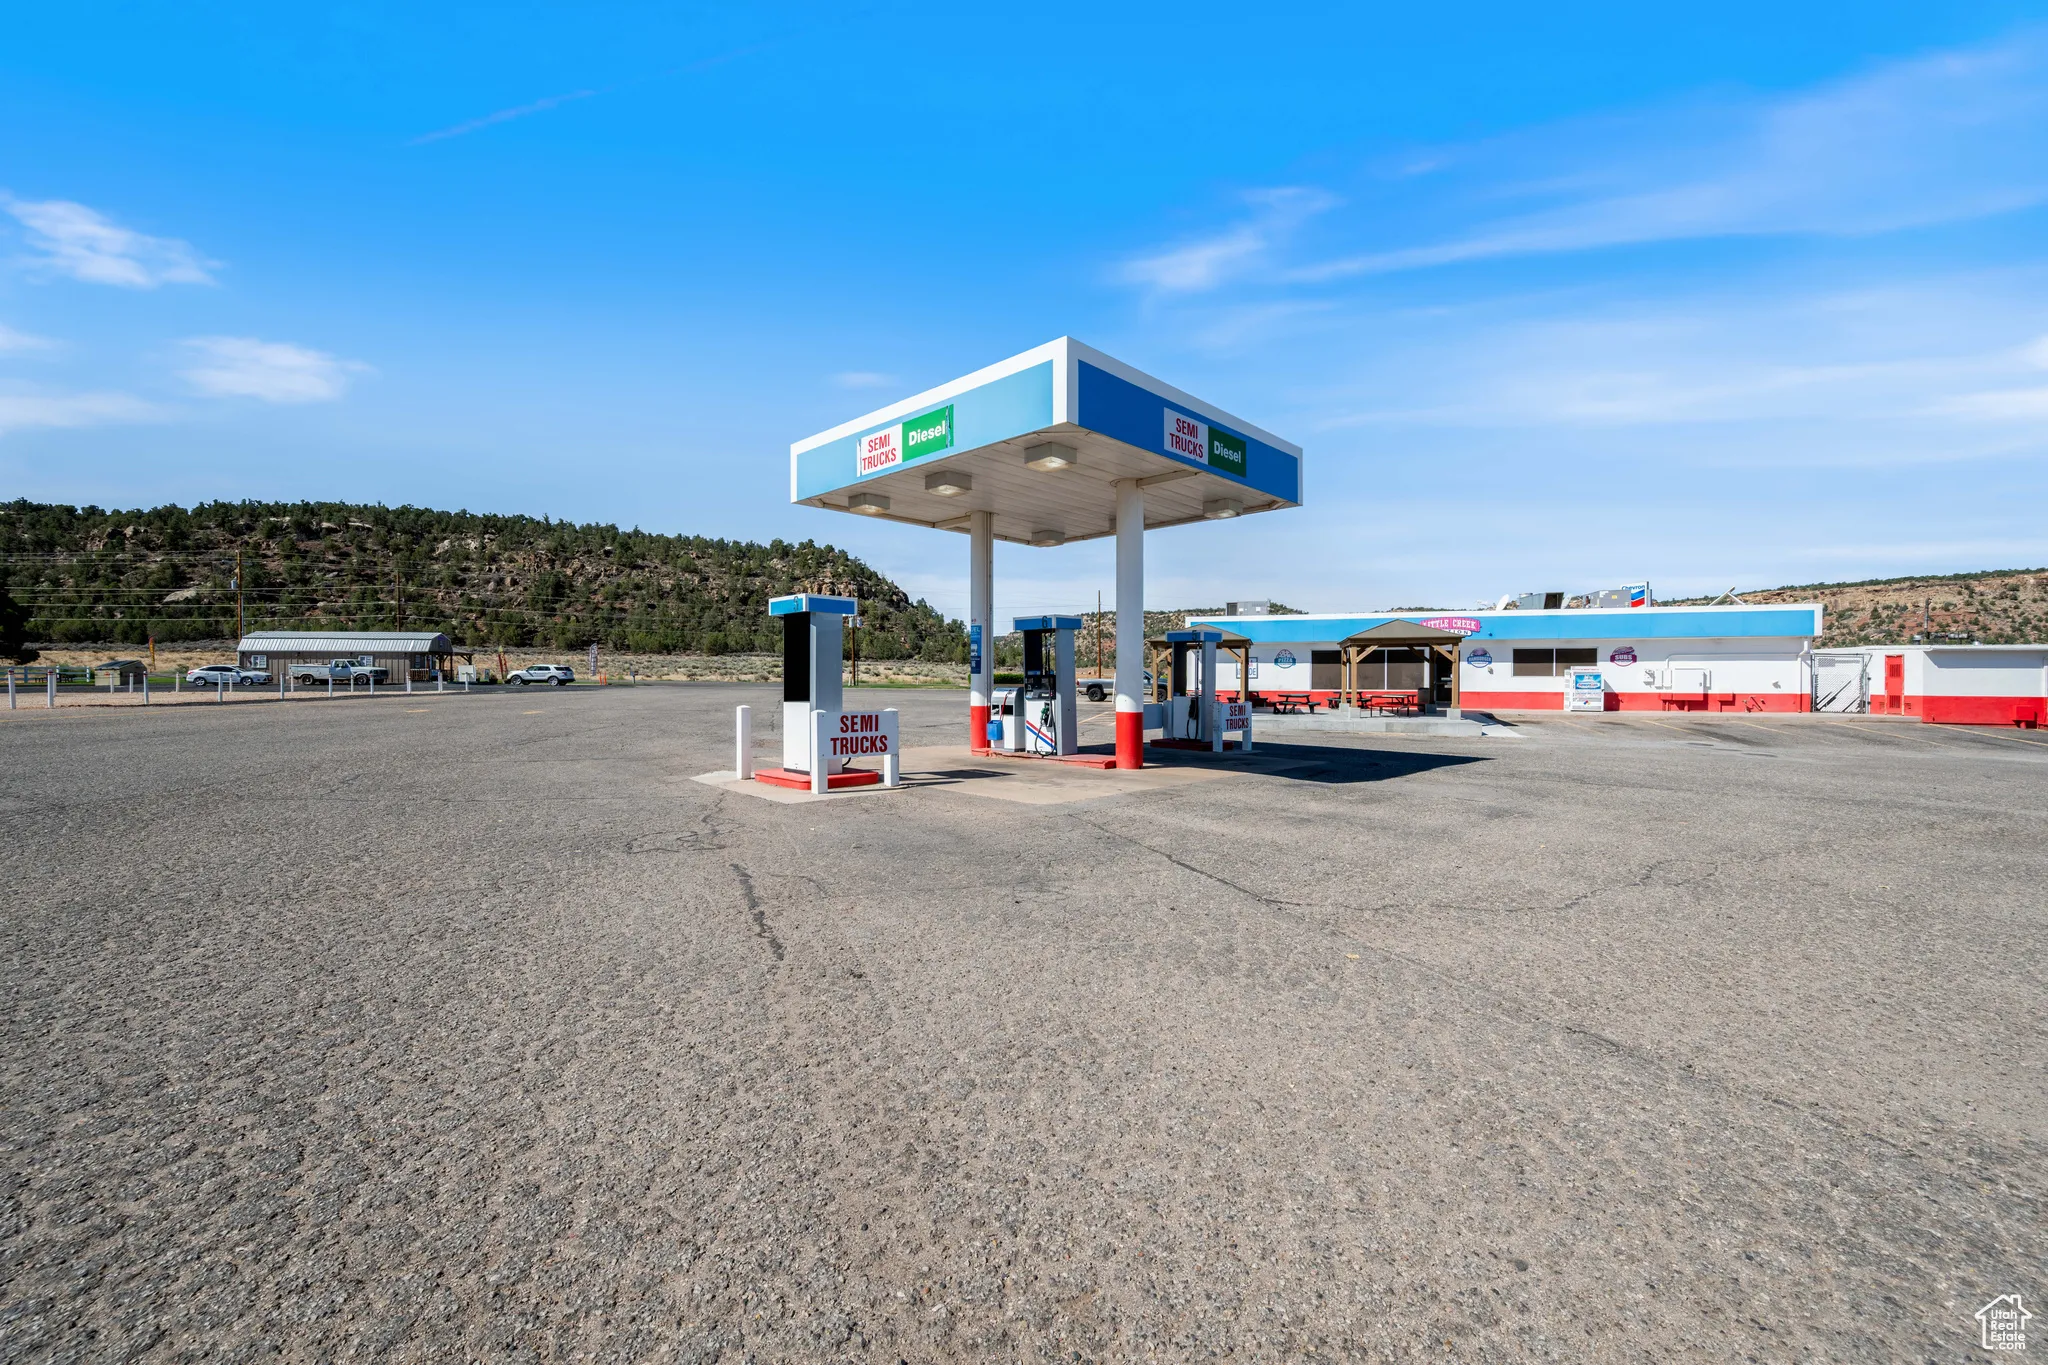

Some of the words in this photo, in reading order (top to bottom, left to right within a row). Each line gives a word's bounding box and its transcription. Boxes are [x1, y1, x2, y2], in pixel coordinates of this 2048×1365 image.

[908, 420, 946, 446] Diesel
[1175, 418, 1198, 439] SEMI
[868, 433, 890, 453] SEMI
[1169, 433, 1204, 458] TRUCKS
[1213, 440, 1242, 463] Diesel
[862, 447, 897, 471] TRUCKS
[1041, 615, 1048, 628] 6
[1452, 619, 1477, 629] CREEK
[1229, 705, 1246, 716] SEMI
[840, 714, 879, 733] SEMI
[1225, 718, 1249, 730] TRUCKS
[830, 735, 888, 755] TRUCKS
